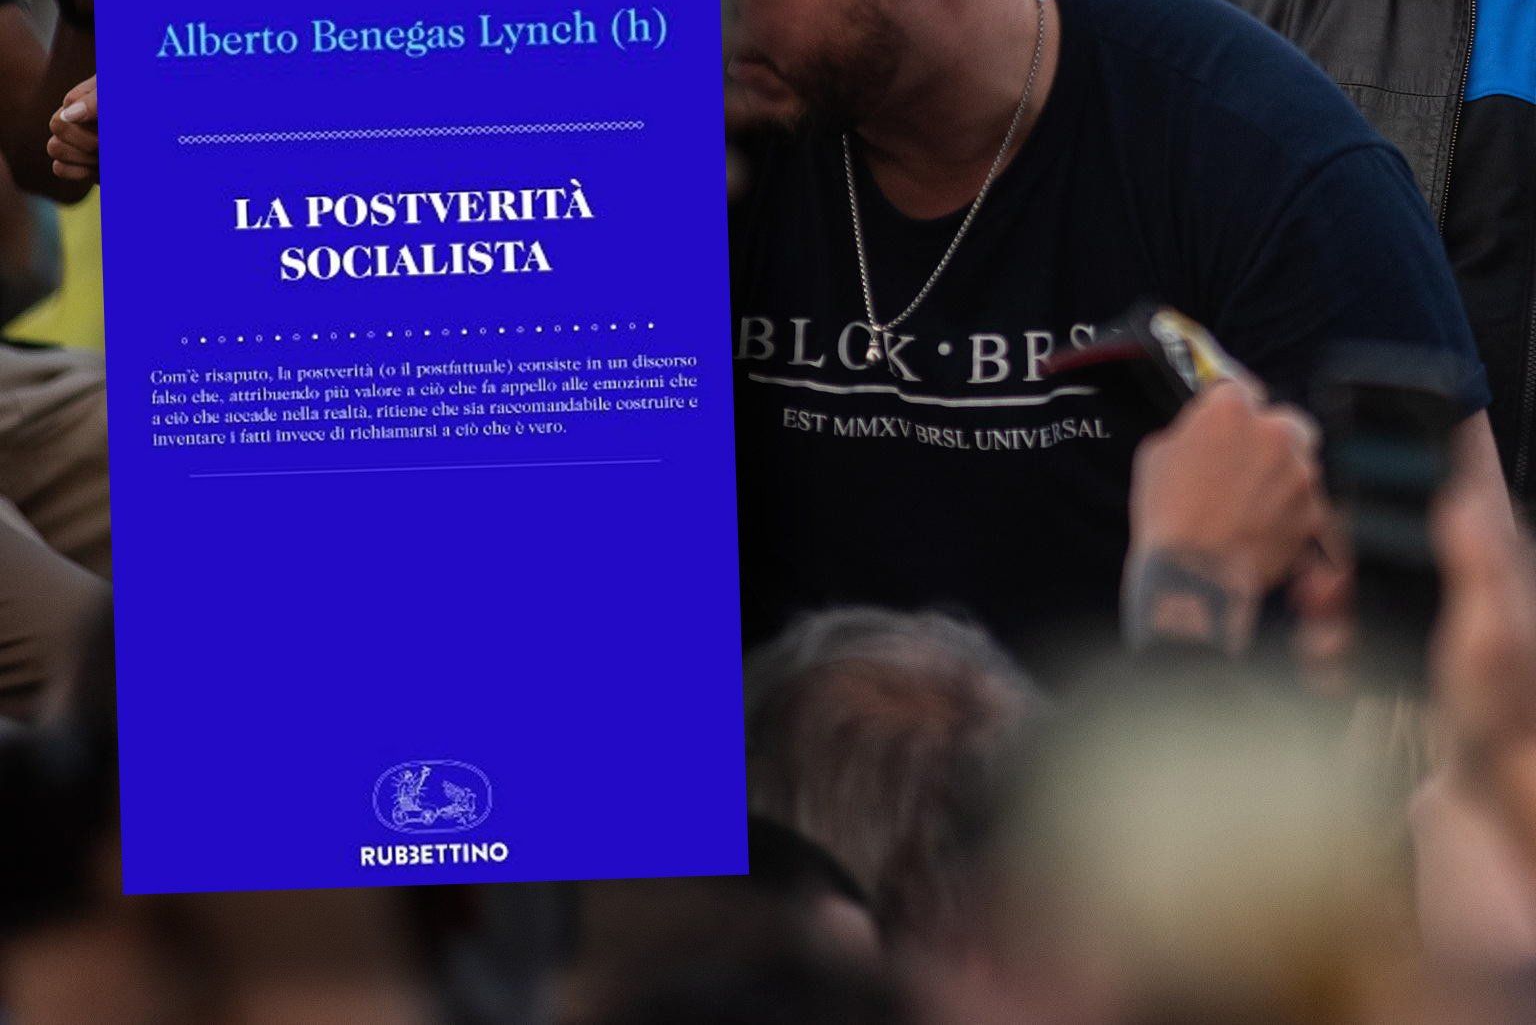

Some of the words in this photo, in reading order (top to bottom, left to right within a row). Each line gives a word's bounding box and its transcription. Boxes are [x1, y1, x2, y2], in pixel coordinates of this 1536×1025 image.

[782, 407, 828, 433] EST
[832, 416, 911, 439] MMXV
[914, 423, 971, 450] BRSL
[974, 418, 1113, 451] UNIVERSAL
